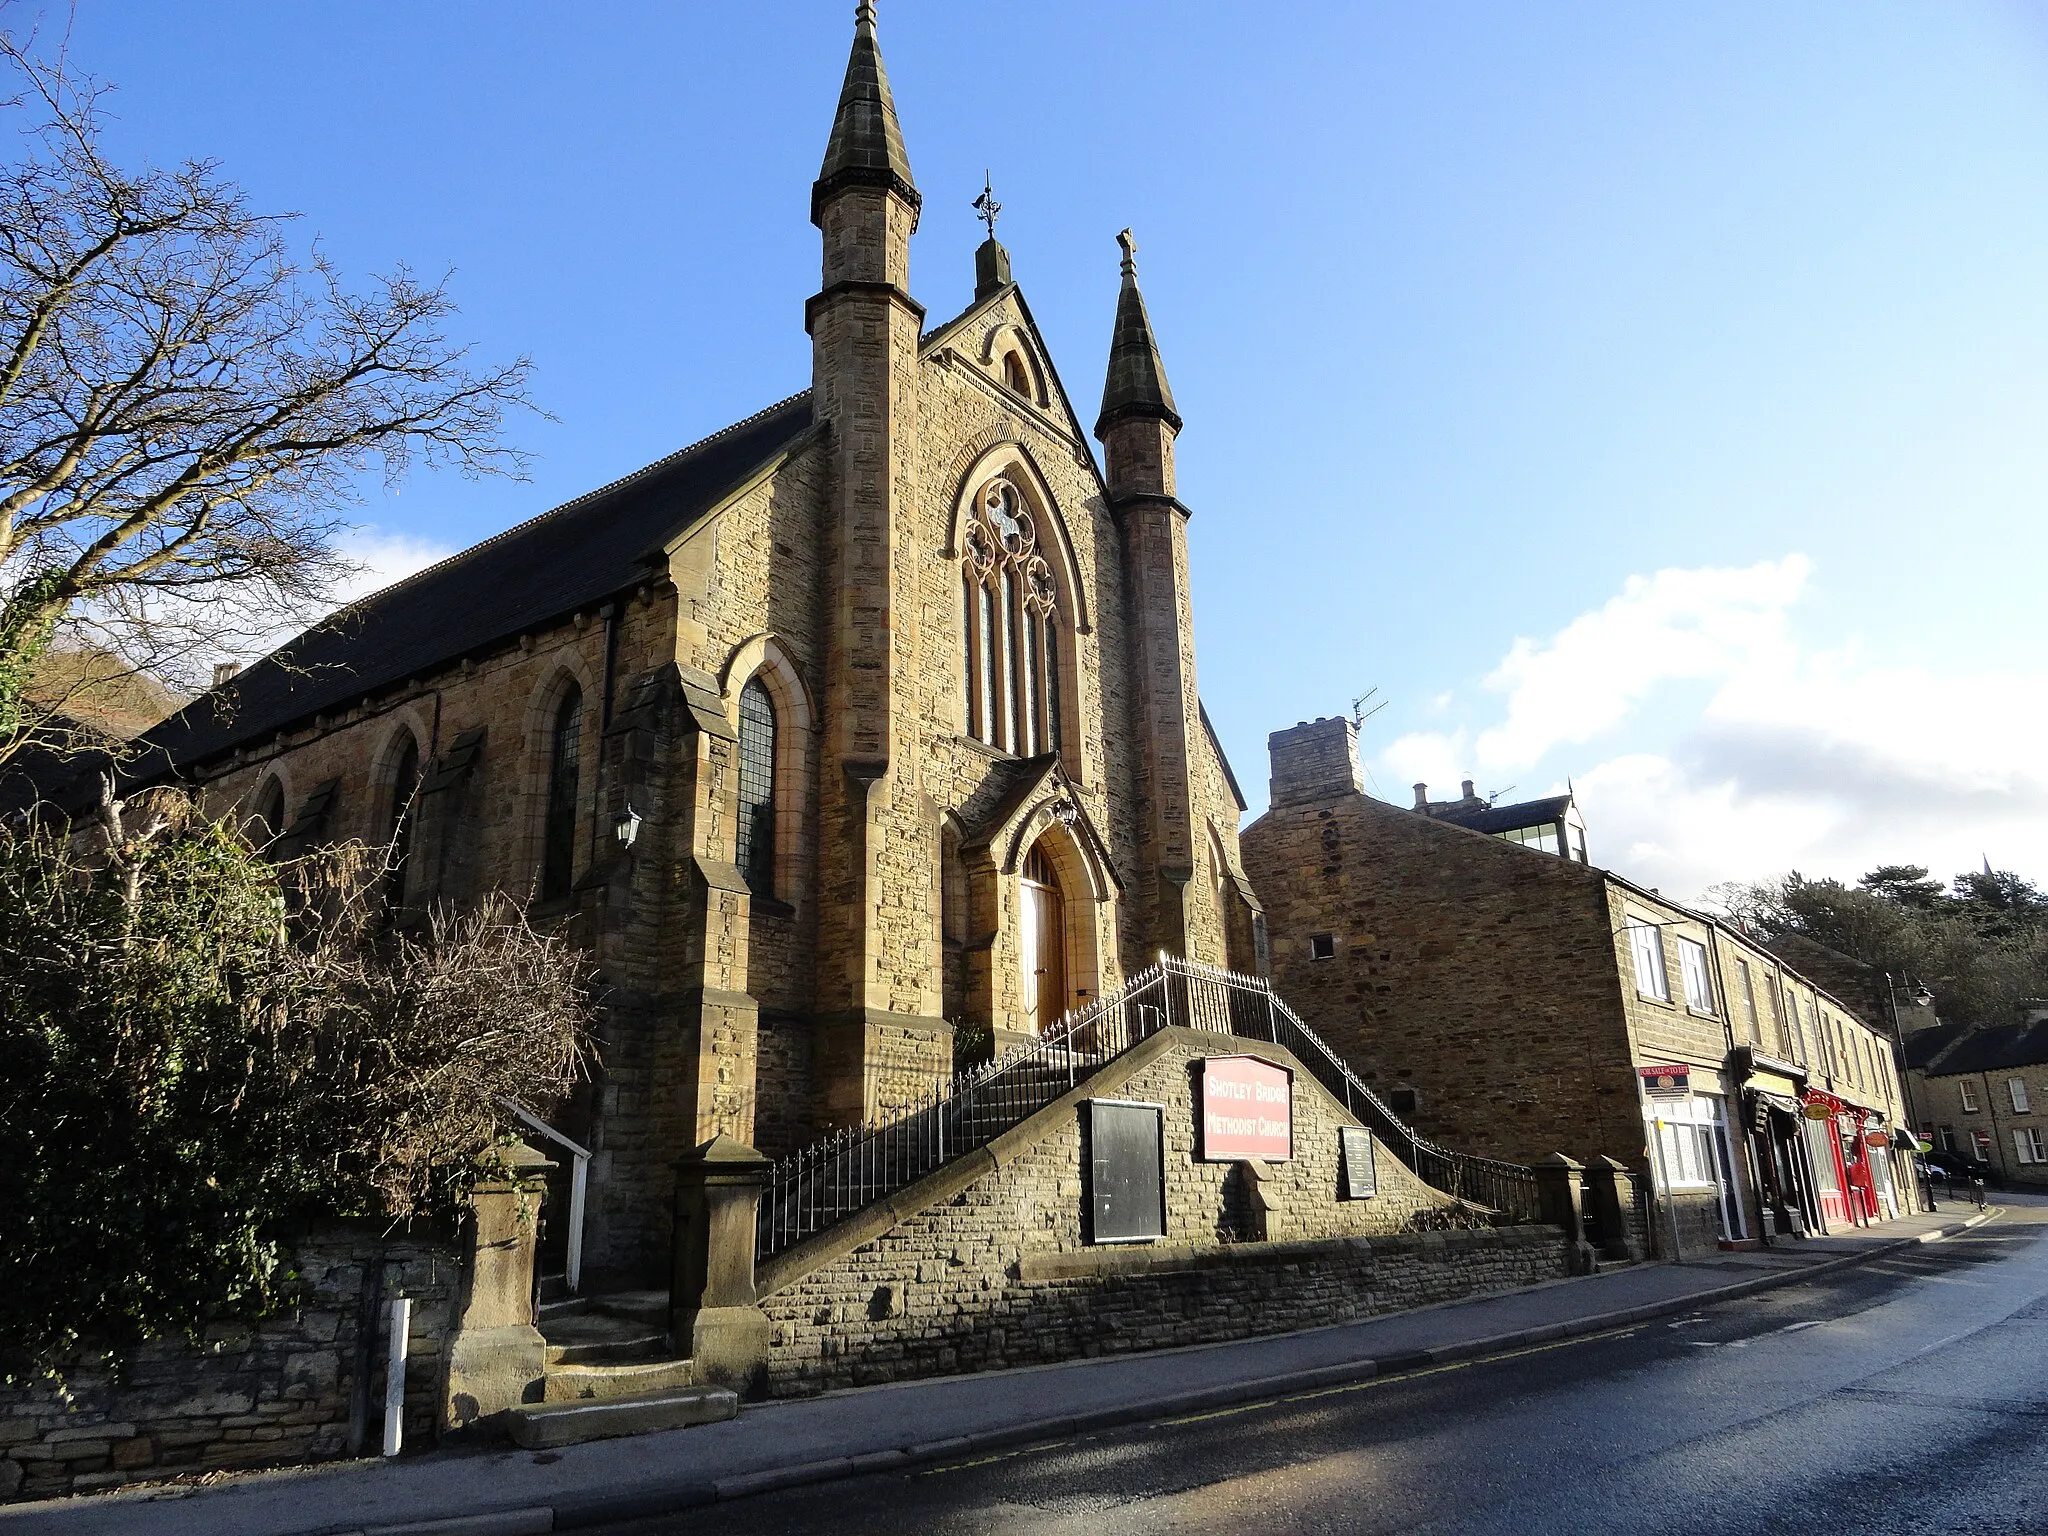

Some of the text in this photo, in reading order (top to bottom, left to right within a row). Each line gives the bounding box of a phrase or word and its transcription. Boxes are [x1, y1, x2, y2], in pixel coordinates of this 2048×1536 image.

[1640, 1067, 1651, 1075] FOR
[1651, 1067, 1665, 1075] SALE
[1669, 1066, 1678, 1074] TO
[1678, 1066, 1689, 1074] LET
[1208, 1074, 1287, 1104] SHOTLEY BRIDGE
[1207, 1112, 1288, 1138] METHODIST CHURCH
